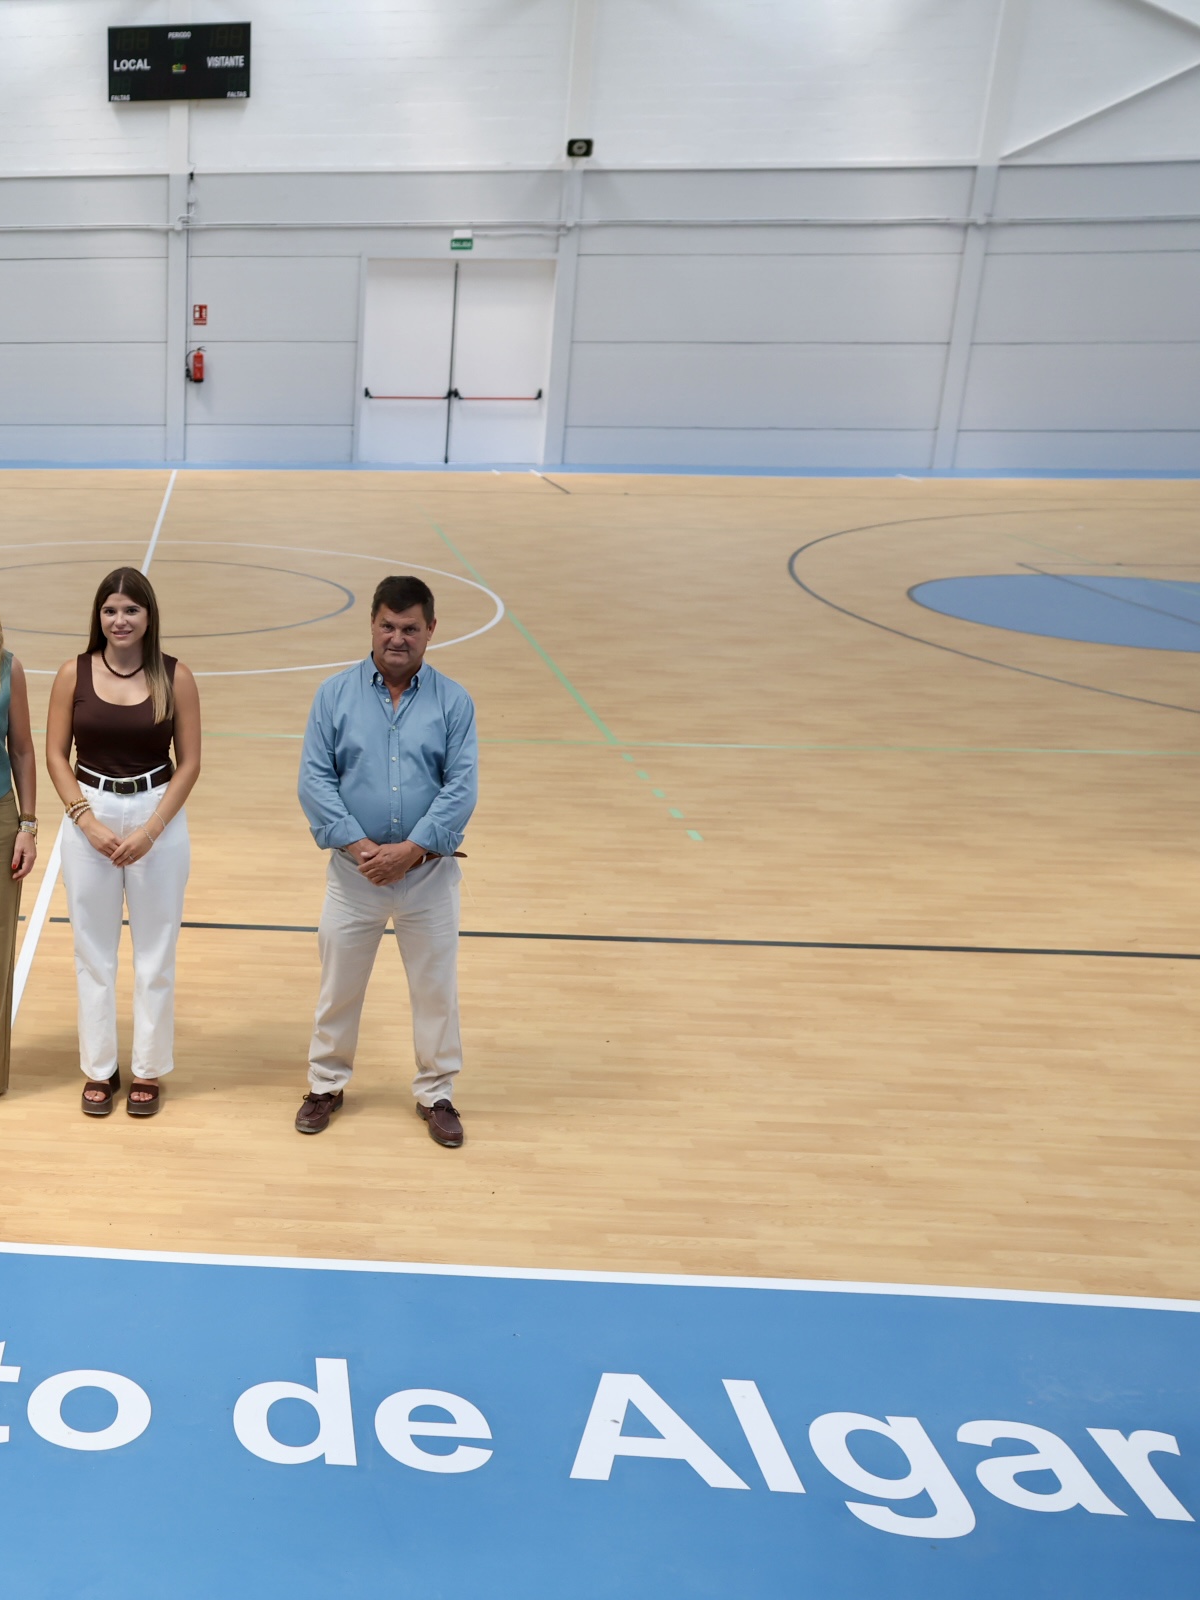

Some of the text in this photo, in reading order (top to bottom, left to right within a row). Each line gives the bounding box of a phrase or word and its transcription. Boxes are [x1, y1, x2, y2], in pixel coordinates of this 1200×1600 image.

[168, 31, 191, 39] PERIODO
[113, 58, 151, 71] LOCAL
[207, 55, 245, 68] VISITANTE
[234, 1358, 493, 1473] de
[570, 1373, 1194, 1538] Algar
